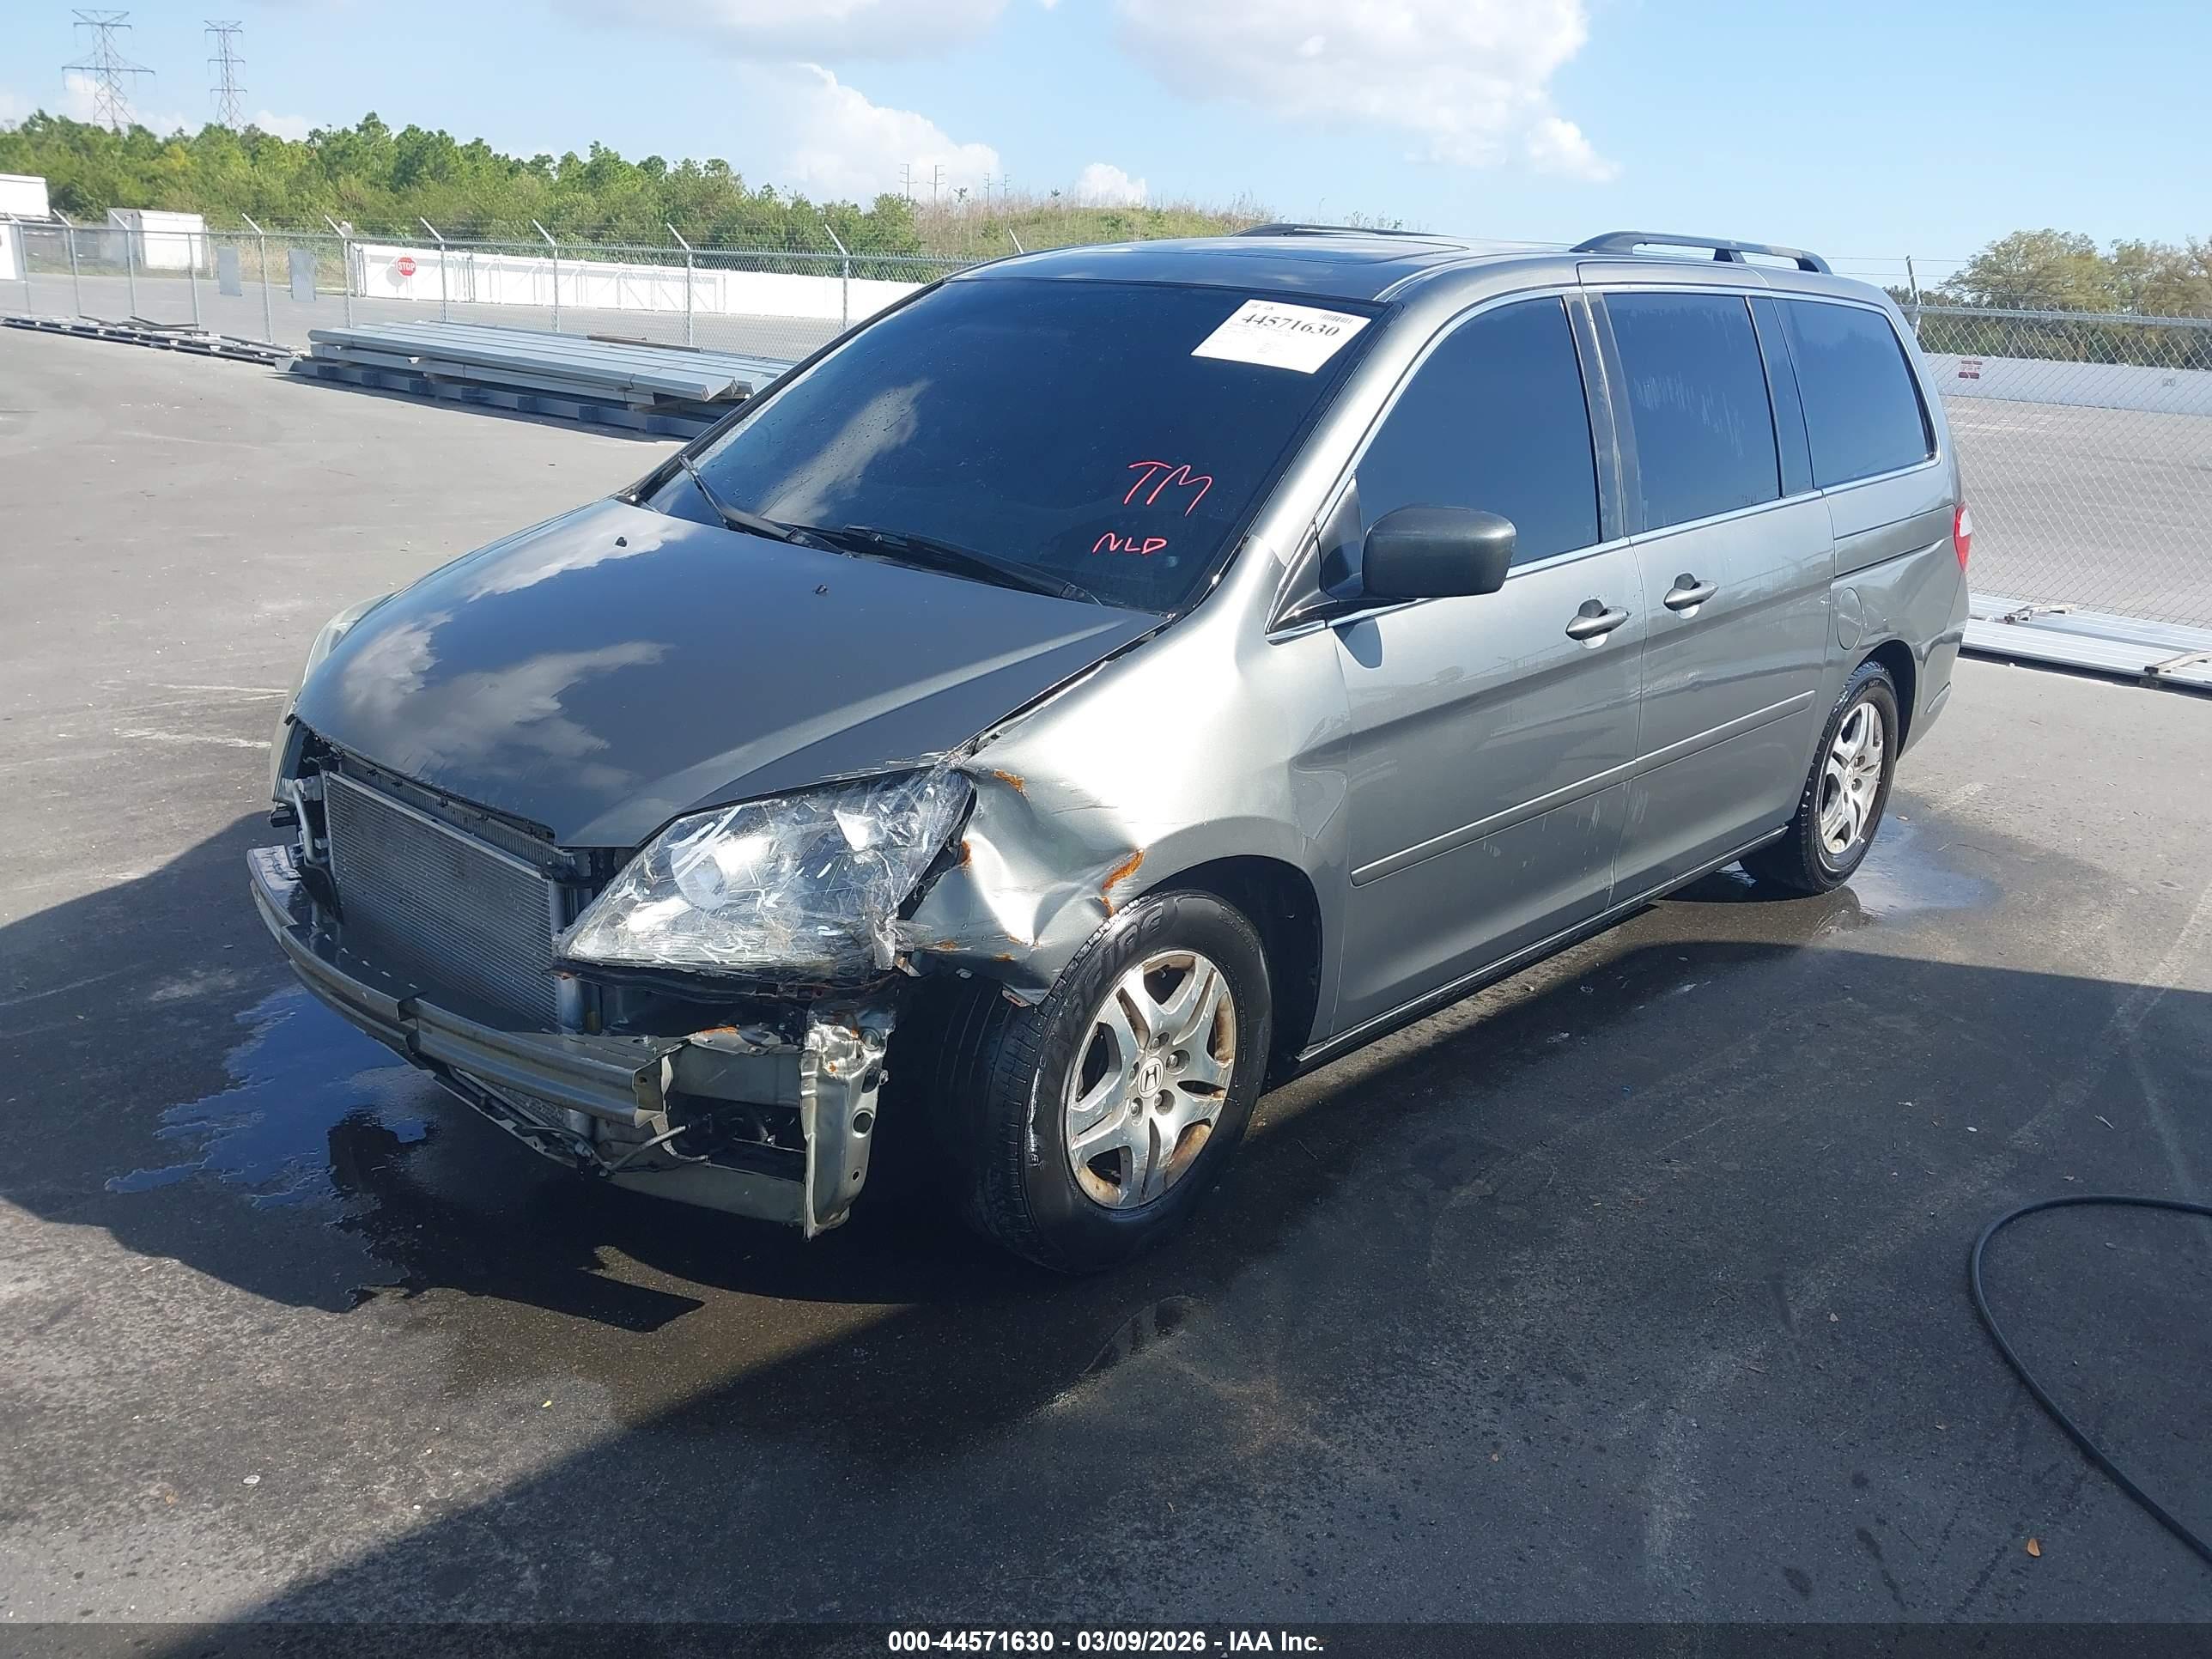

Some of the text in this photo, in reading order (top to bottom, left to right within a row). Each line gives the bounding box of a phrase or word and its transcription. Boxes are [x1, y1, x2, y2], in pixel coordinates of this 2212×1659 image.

[398, 261, 415, 271] STOP
[1242, 313, 1340, 337] 44571630
[1123, 461, 1212, 517] TM
